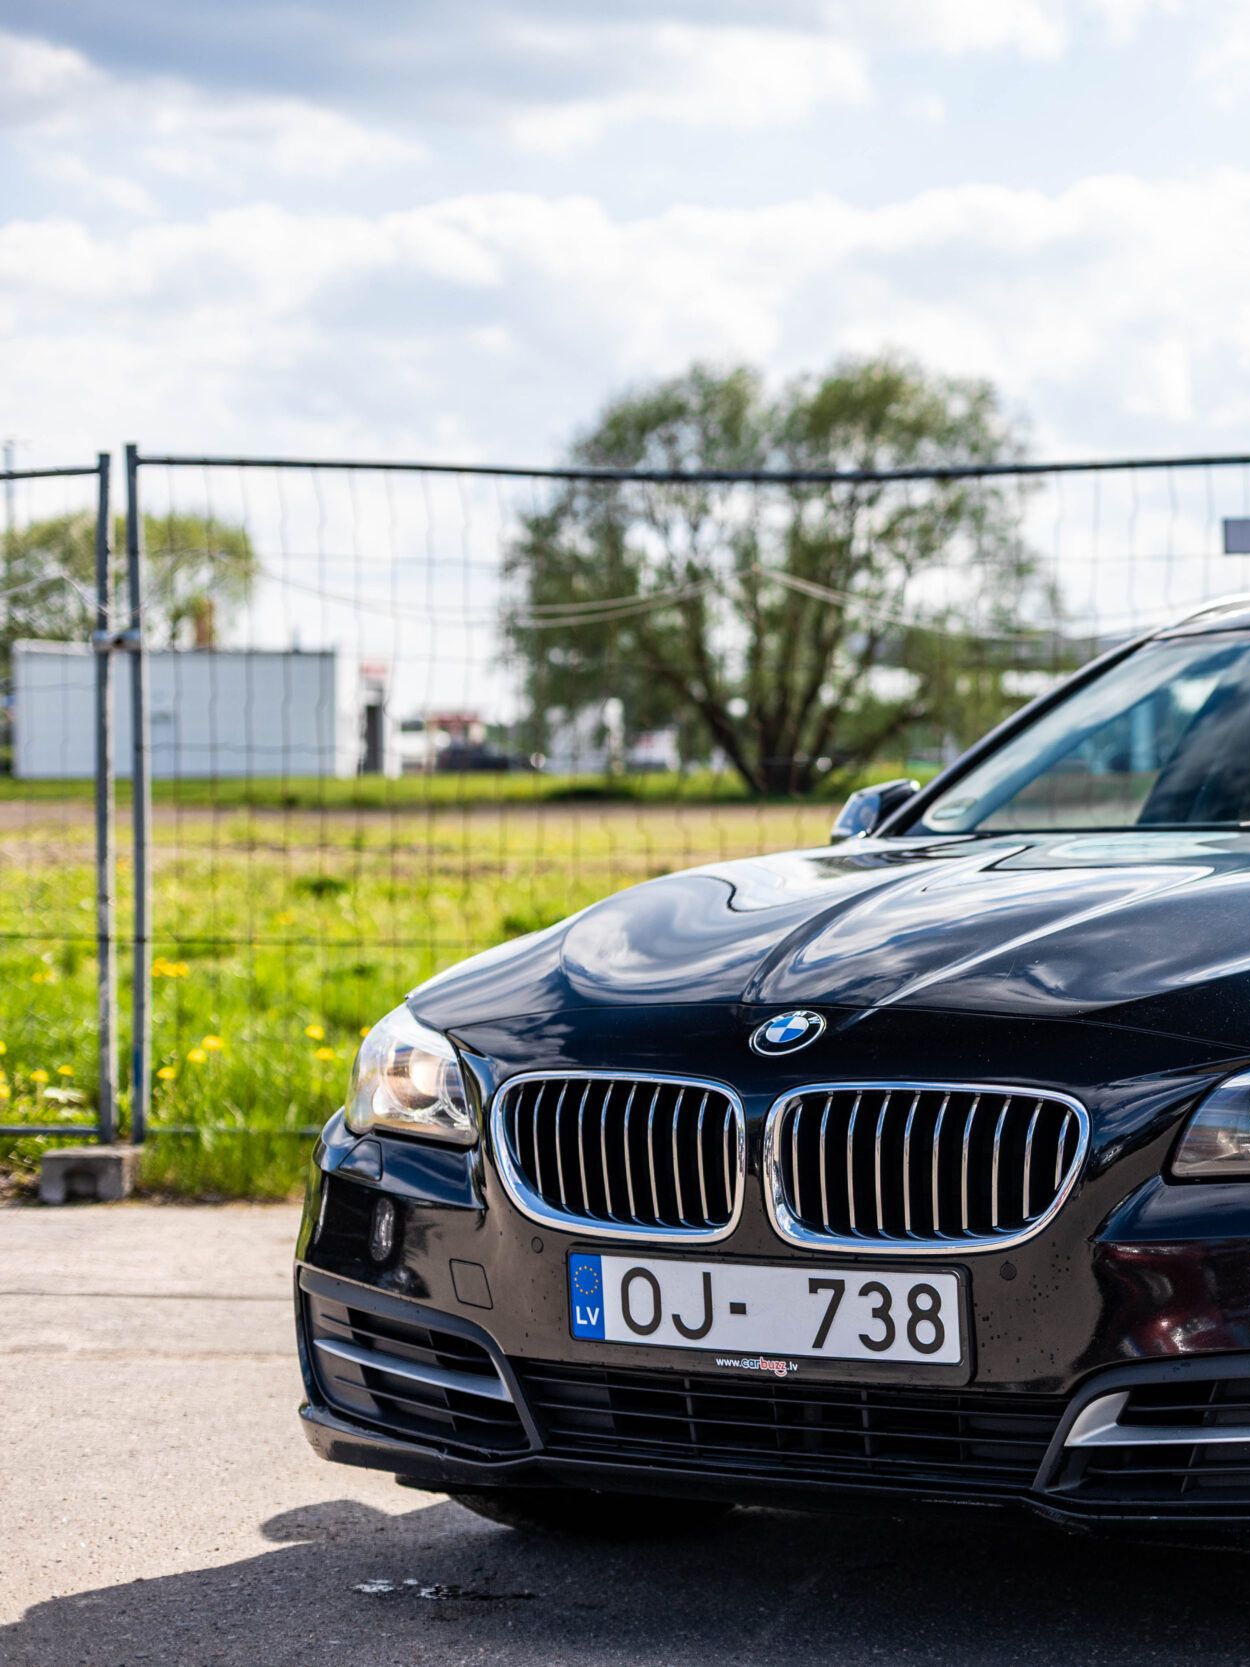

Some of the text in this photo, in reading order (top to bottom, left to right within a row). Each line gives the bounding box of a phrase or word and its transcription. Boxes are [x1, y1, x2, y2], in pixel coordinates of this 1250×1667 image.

[575, 1305, 600, 1326] LV
[807, 1277, 946, 1355] 738
[715, 1356, 799, 1377] www.carbuzz.lv
